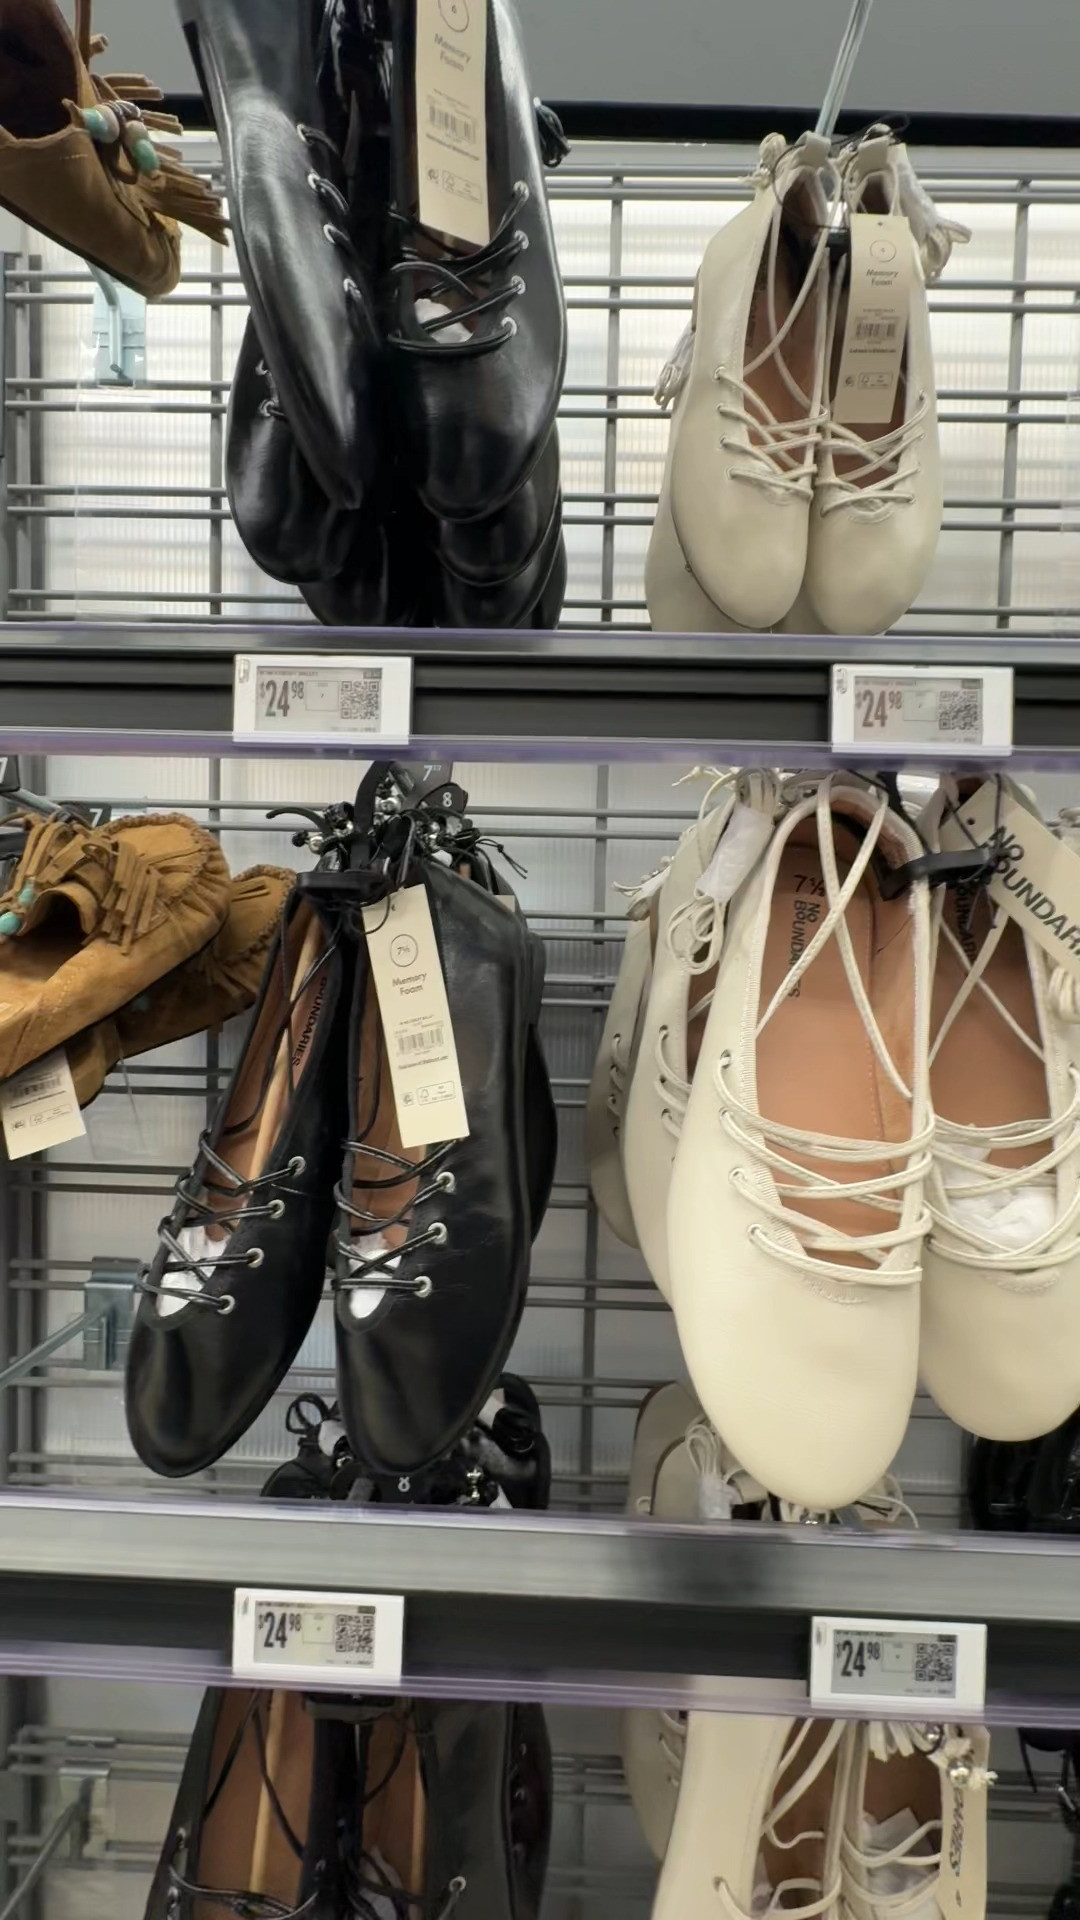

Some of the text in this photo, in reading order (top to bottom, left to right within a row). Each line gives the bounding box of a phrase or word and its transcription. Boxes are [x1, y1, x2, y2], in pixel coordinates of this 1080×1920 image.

[434, 33, 471, 64] Memory
[440, 50, 465, 72] Foam
[866, 268, 899, 278] Memory
[871, 277, 893, 287] Foam
[442, 791, 453, 808] 8
[89, 807, 105, 828] 7
[807, 902, 821, 923] NO
[990, 858, 1080, 957] OUNDAR
[391, 972, 428, 988] Memory
[399, 984, 424, 997] Foam
